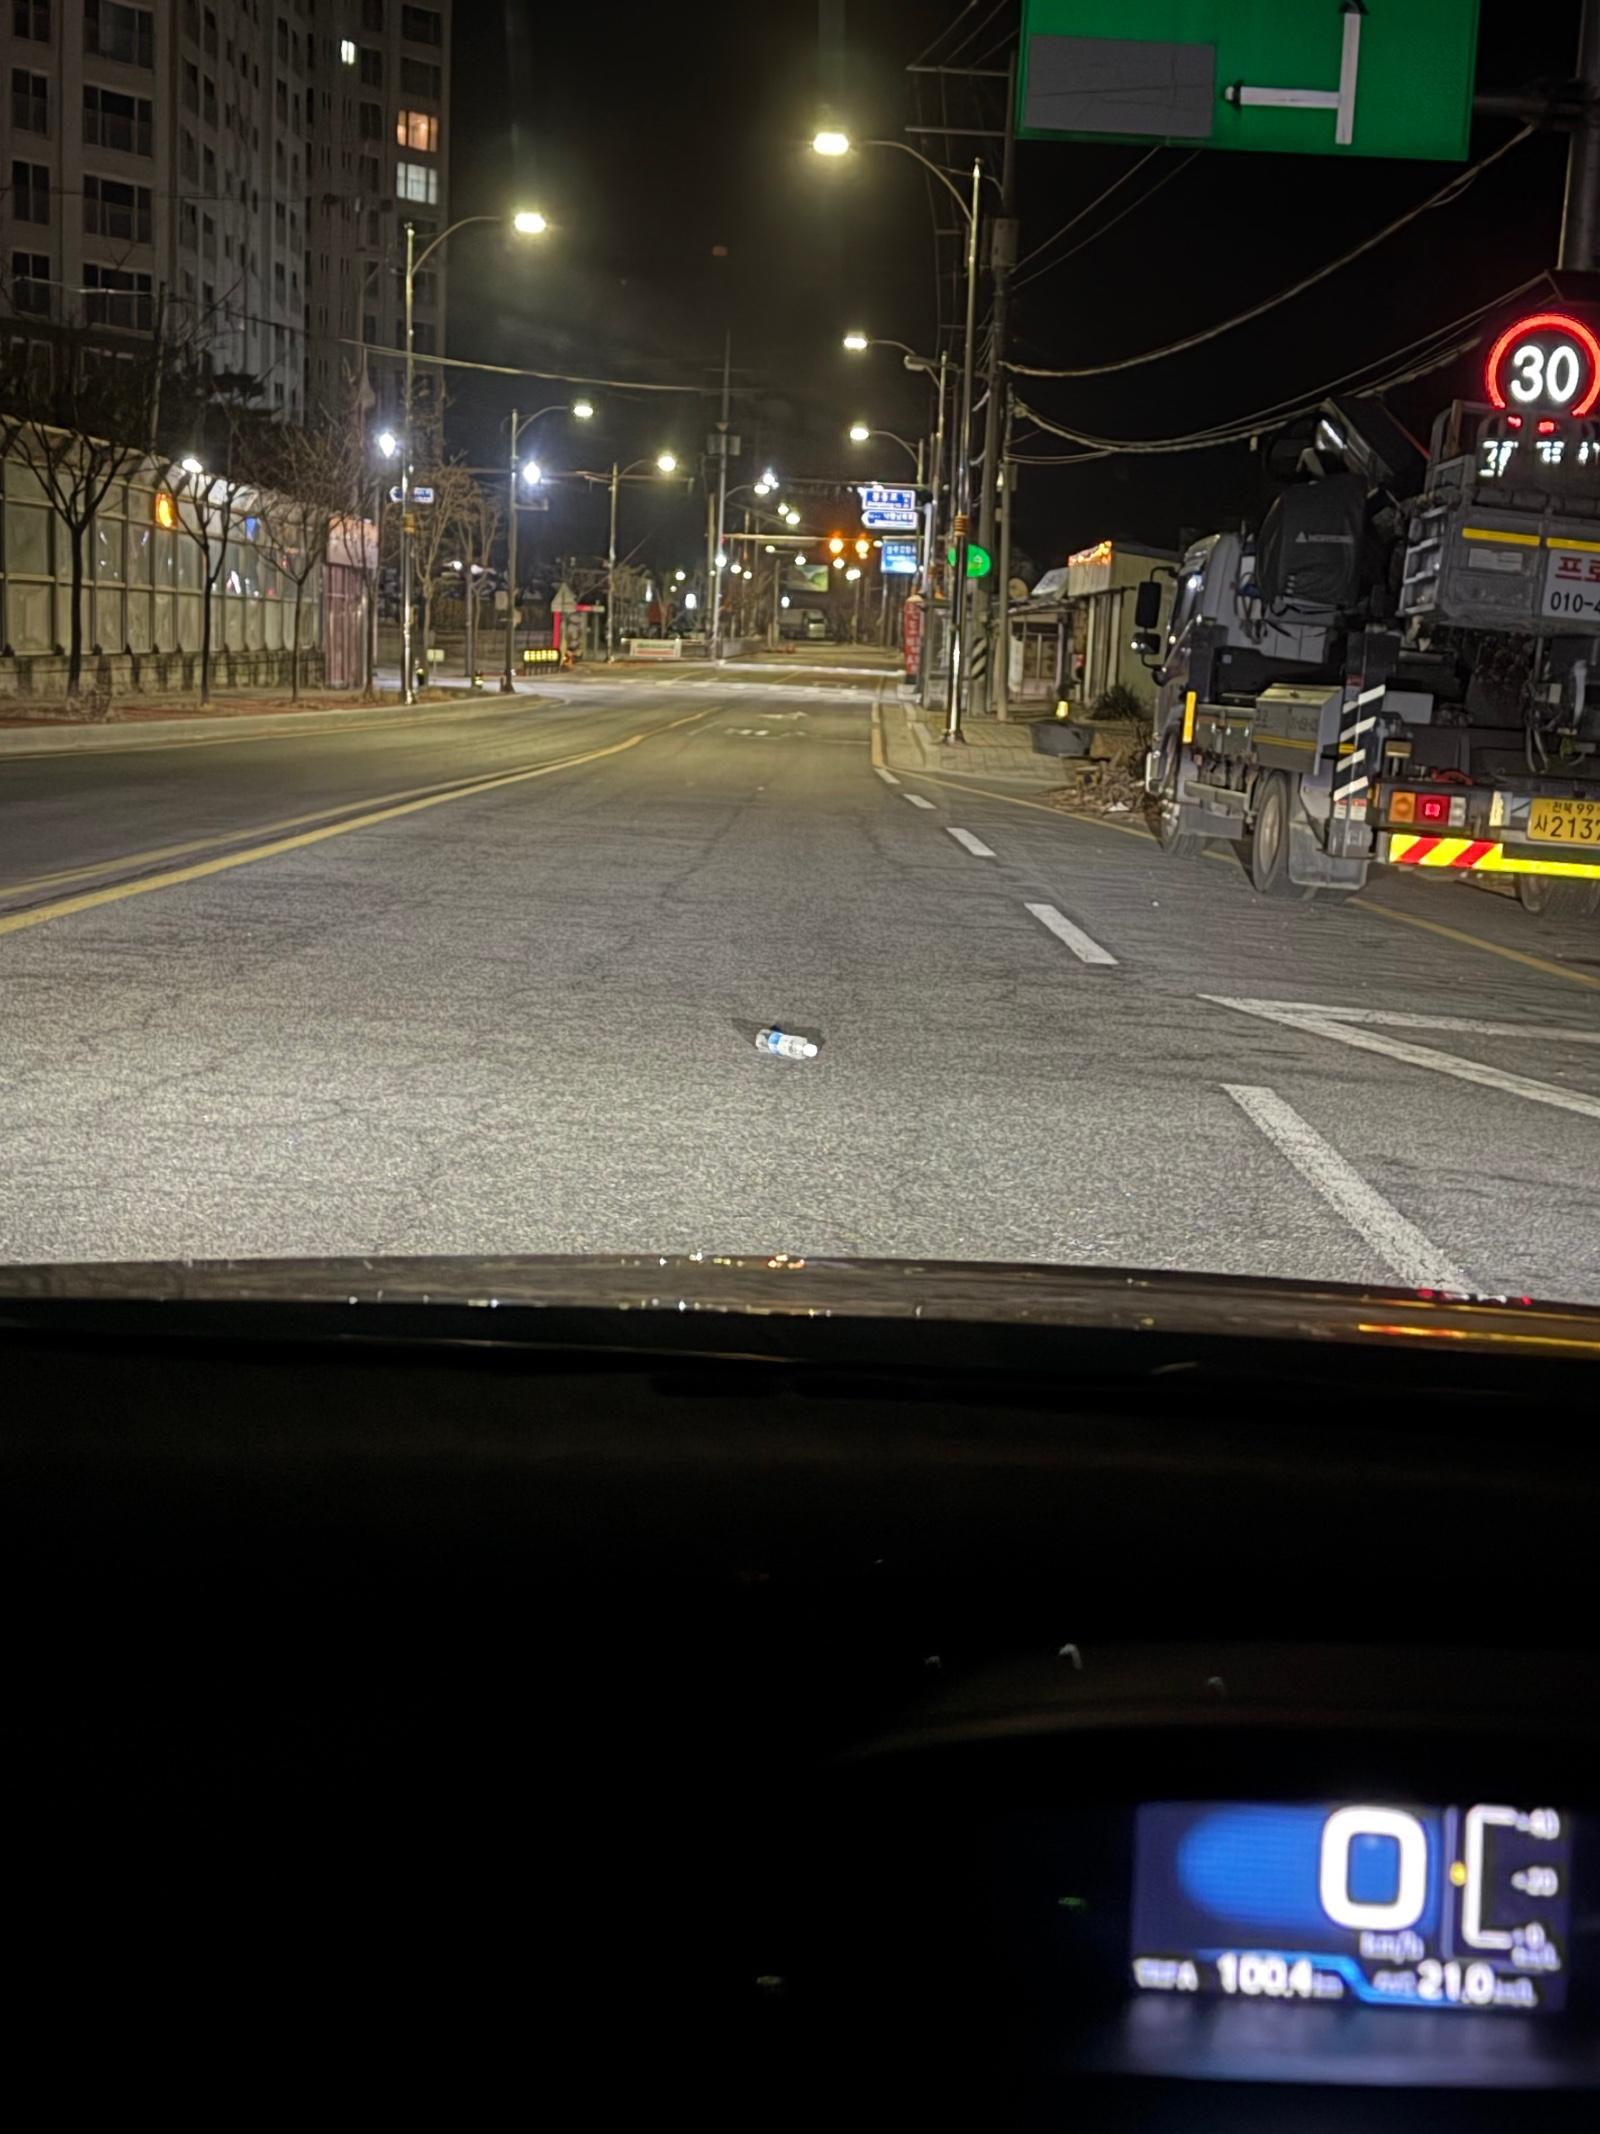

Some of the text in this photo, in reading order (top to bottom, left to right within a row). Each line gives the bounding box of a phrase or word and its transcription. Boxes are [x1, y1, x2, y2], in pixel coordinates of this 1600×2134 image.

[1511, 345, 1580, 402] 30
[1320, 1806, 1427, 1931] 0
[1216, 1952, 1312, 1998] 100.4
[1417, 1959, 1495, 2005] 21.0
